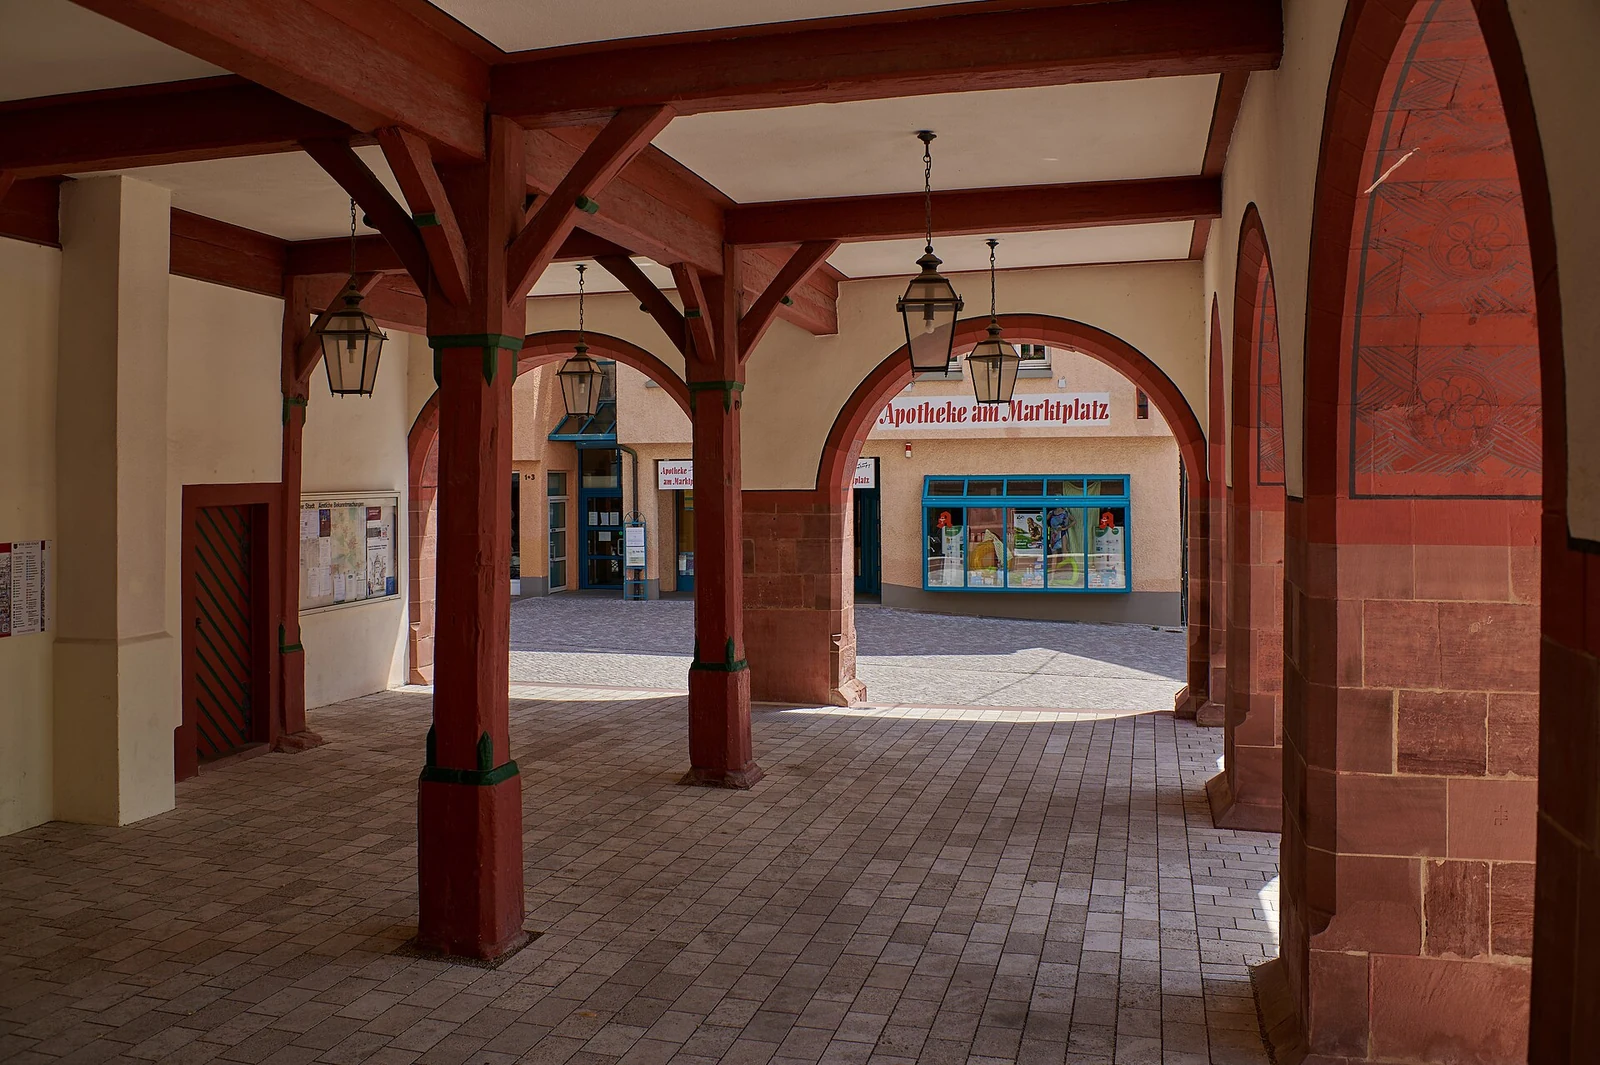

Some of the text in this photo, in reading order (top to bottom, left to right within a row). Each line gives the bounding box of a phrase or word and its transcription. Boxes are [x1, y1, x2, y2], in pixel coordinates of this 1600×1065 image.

[879, 397, 1110, 428] Apotheke am Marktplatz
[660, 466, 688, 476] Apotheke
[853, 475, 870, 486] platz
